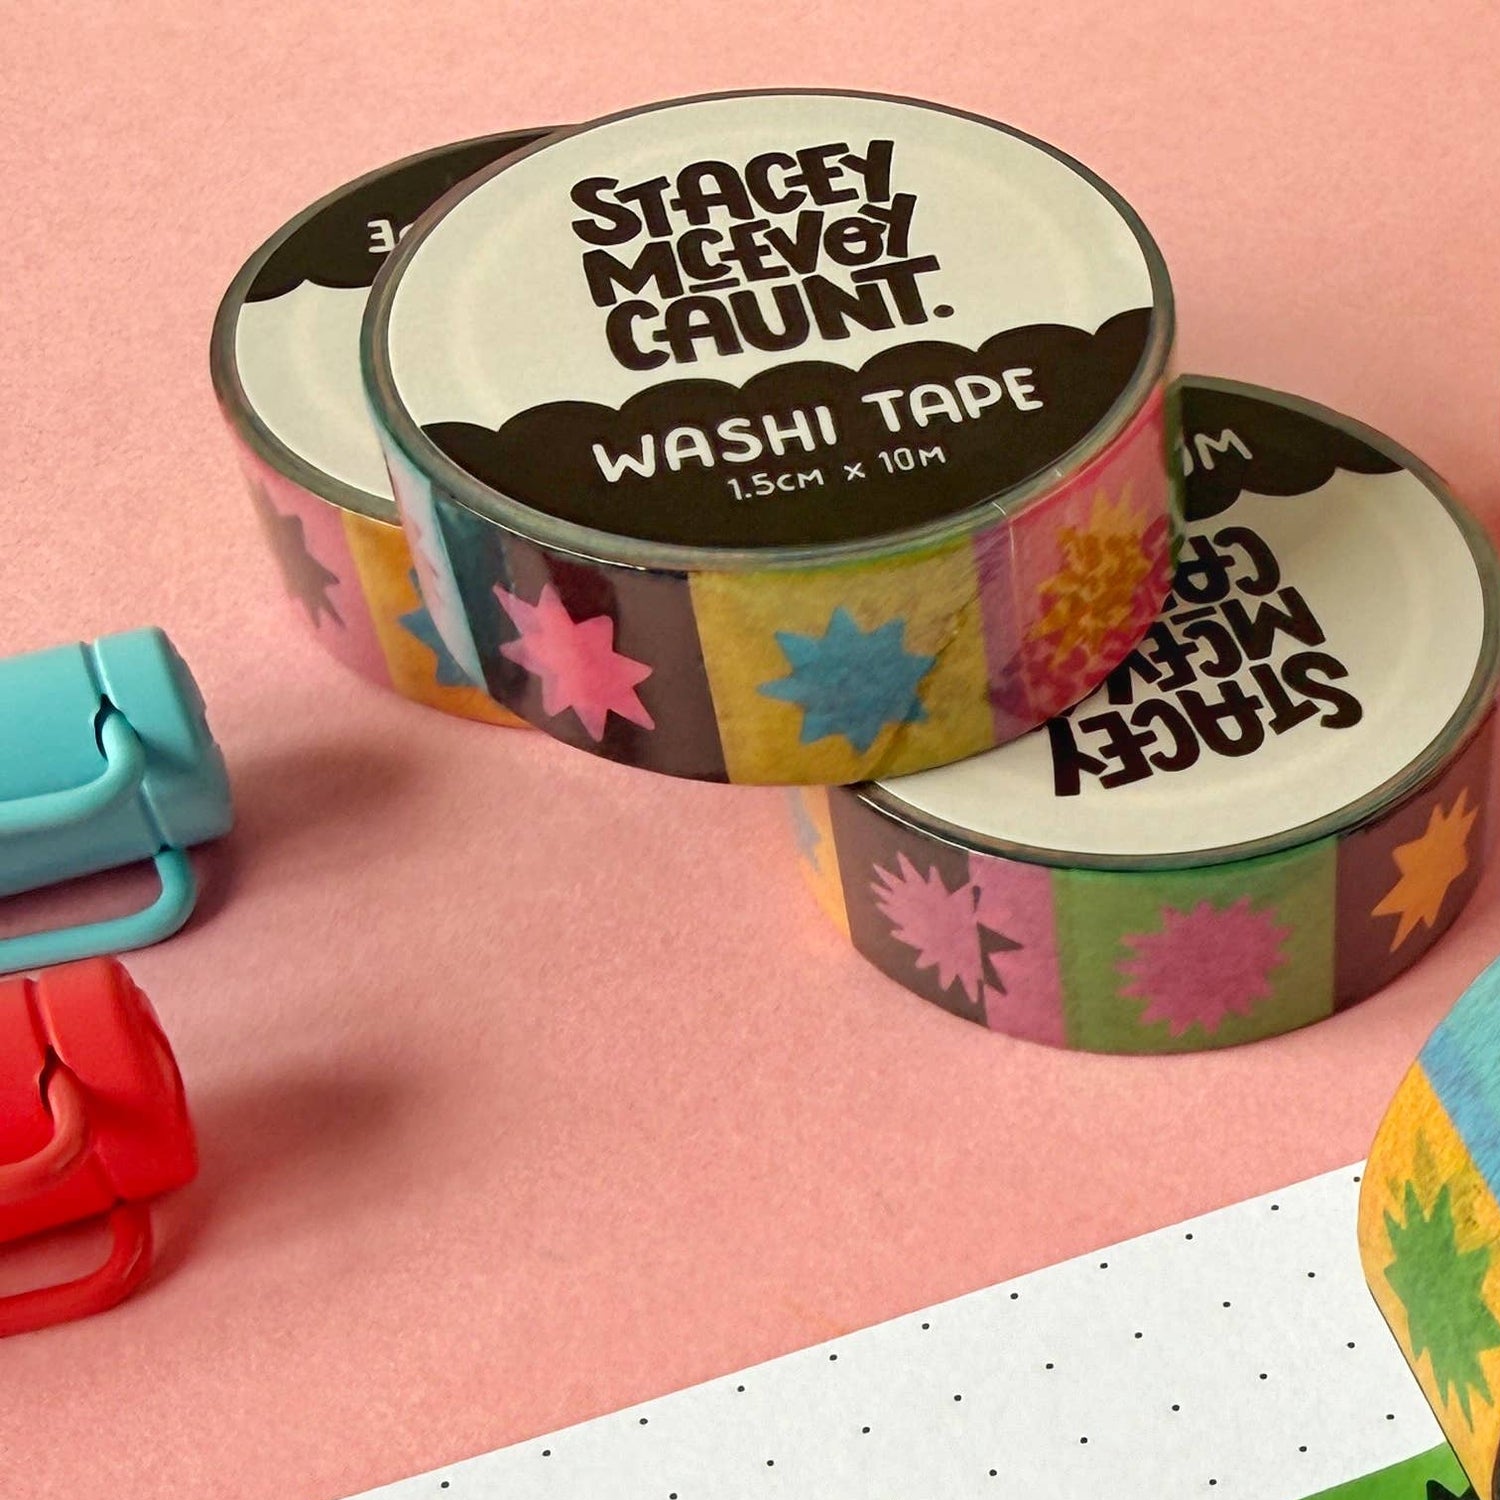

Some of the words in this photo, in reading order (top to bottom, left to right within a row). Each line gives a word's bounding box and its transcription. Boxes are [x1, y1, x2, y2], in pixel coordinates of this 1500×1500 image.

[571, 139, 895, 246] STACEY
[582, 193, 918, 307] MCEVOY
[606, 256, 955, 371] CAUNT.
[593, 405, 838, 484] WASHI
[862, 367, 1044, 433] TAPE
[1096, 586, 1327, 706] MCEV
[1046, 651, 1363, 797] STACEY
